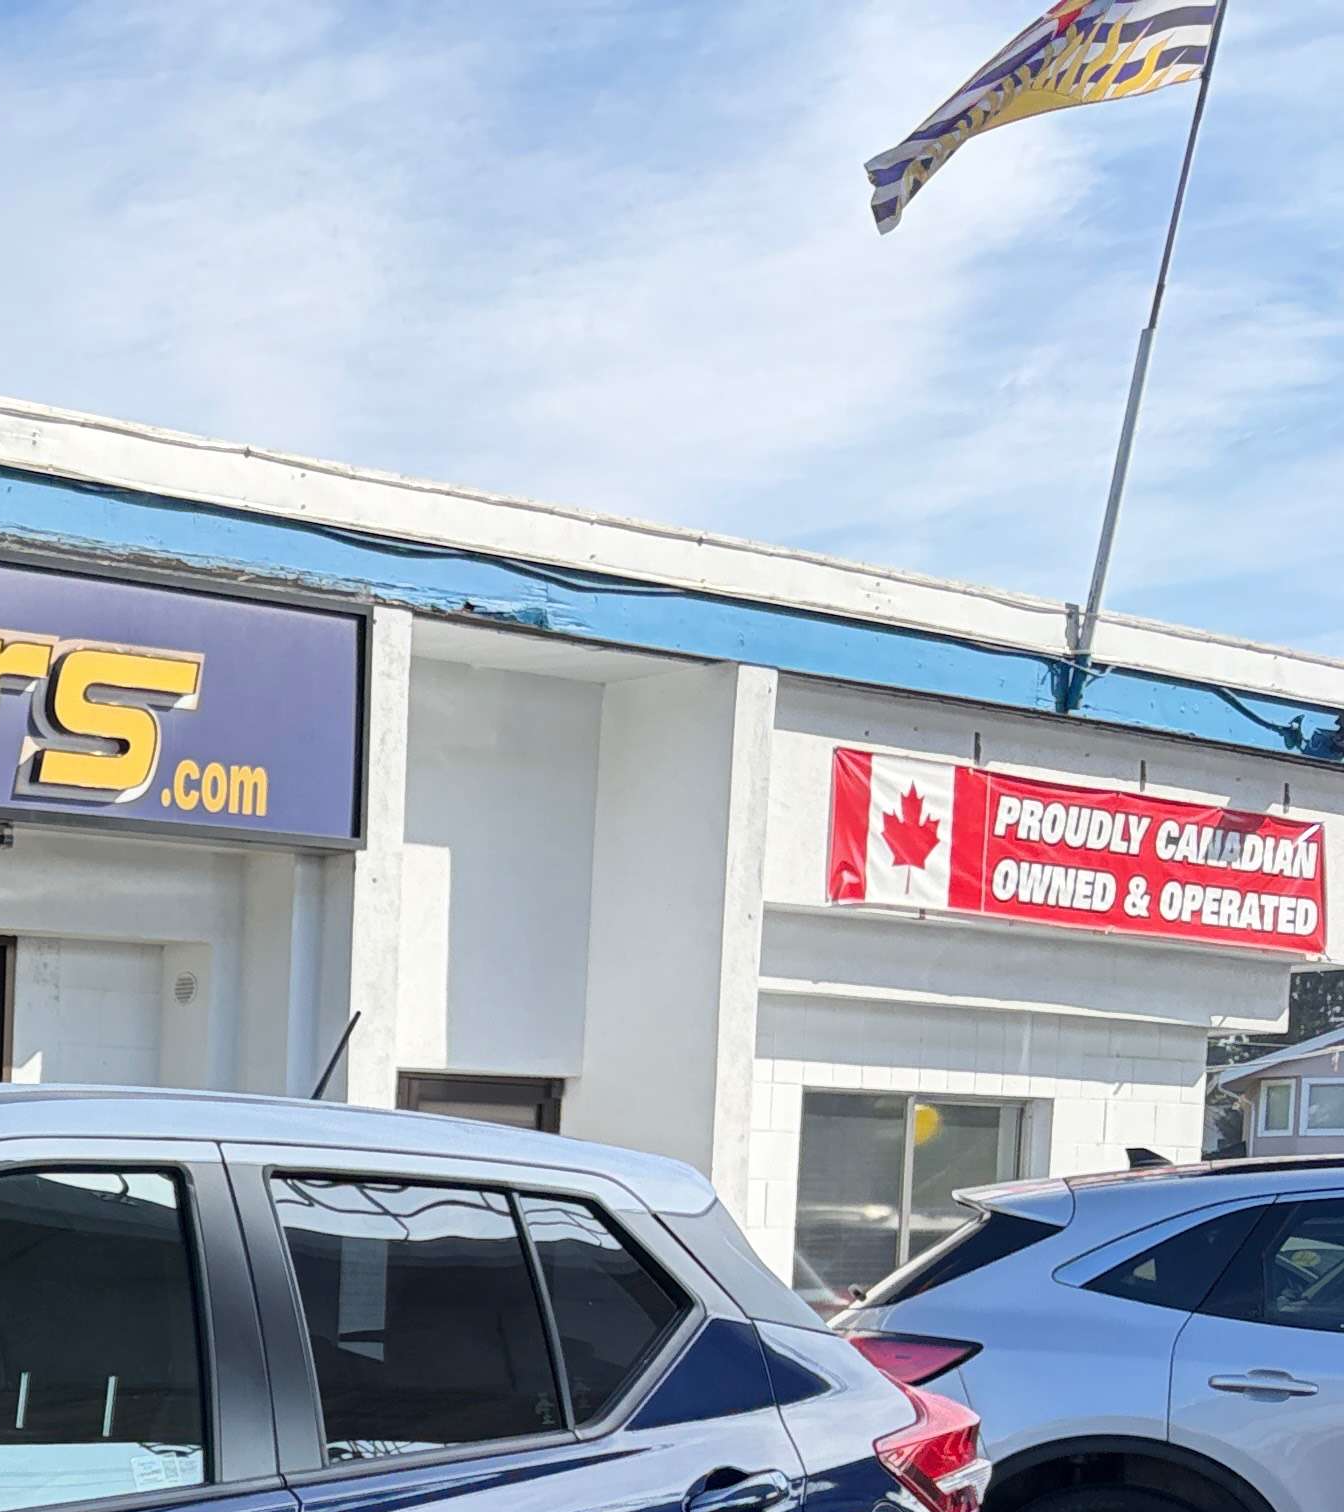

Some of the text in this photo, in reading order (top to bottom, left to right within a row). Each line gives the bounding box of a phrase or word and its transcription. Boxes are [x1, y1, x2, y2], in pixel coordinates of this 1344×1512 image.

[160, 758, 268, 817] .com
[992, 796, 1318, 880] PROUDLY CANADIAN
[991, 858, 1319, 937] OWNED & OPERATED
